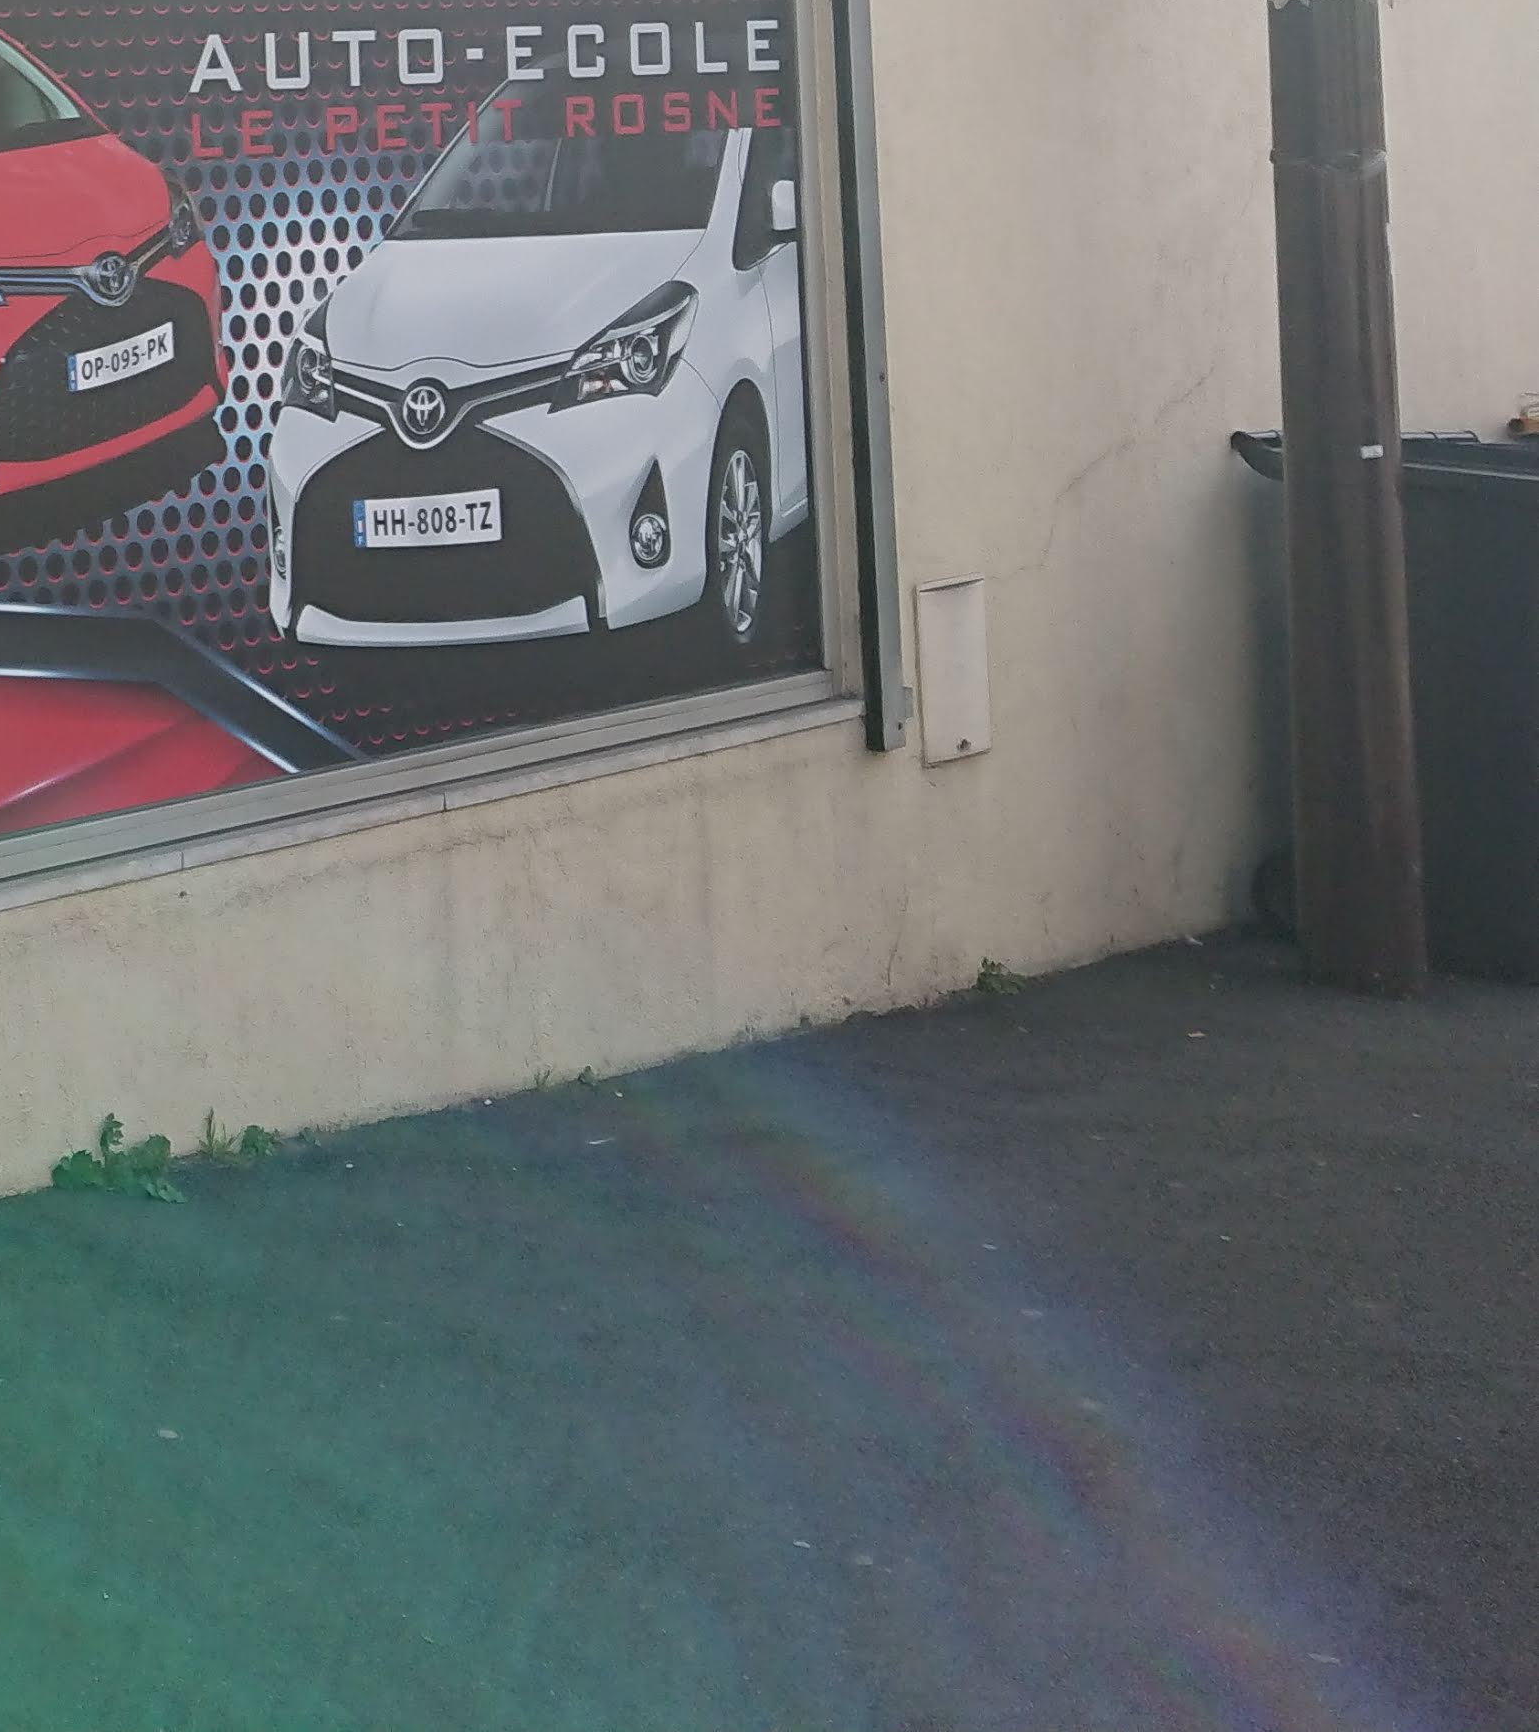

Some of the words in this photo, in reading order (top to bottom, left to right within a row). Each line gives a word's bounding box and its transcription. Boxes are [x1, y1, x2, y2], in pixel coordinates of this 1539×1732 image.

[189, 19, 781, 93] AUTO-ECOLE
[191, 109, 274, 158] LE
[326, 97, 522, 151] PETIT
[564, 87, 782, 139] ROSNE
[81, 338, 169, 382] OP-095-PK
[373, 502, 493, 537] HH-808-TZ
